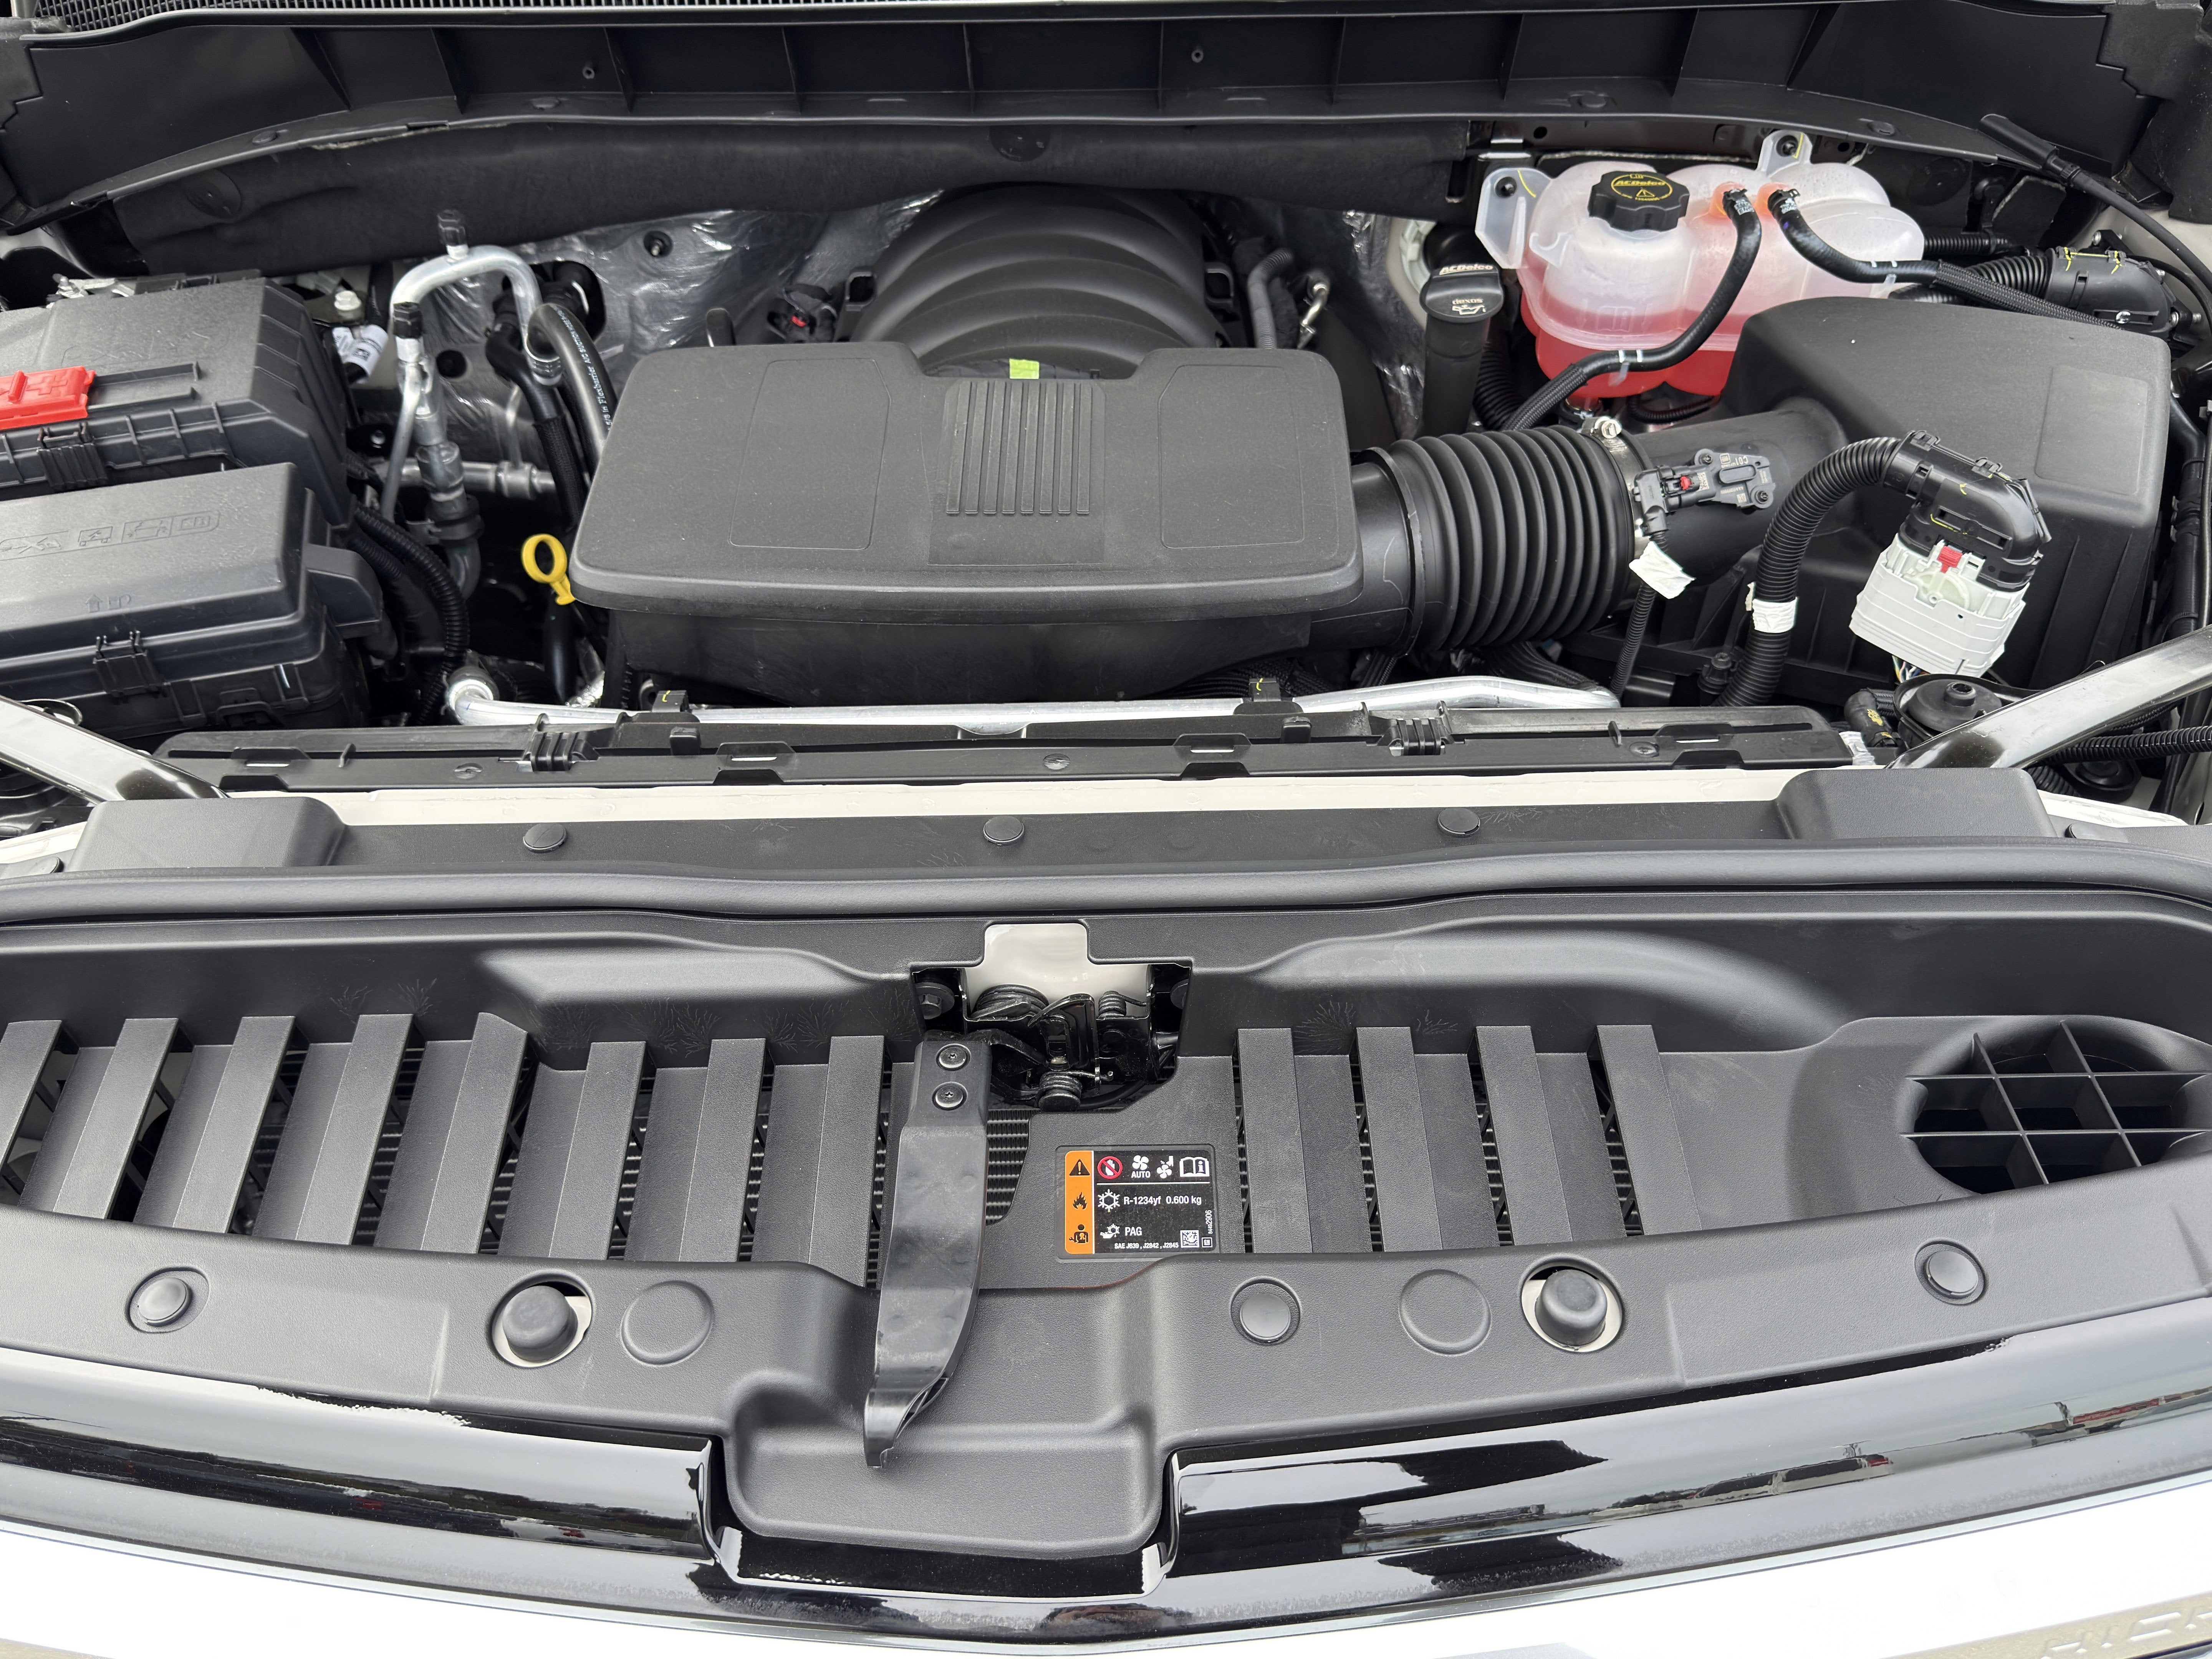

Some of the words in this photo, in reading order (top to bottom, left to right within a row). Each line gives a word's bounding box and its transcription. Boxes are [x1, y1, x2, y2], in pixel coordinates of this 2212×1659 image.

[1439, 263, 1493, 275] ACDelco
[1131, 1171, 1151, 1179] AUTO
[1123, 1196, 1161, 1206] R-1234yf
[1166, 1196, 1189, 1205] 0.600
[1191, 1196, 1202, 1206] kg
[1125, 1227, 1142, 1236] PAG
